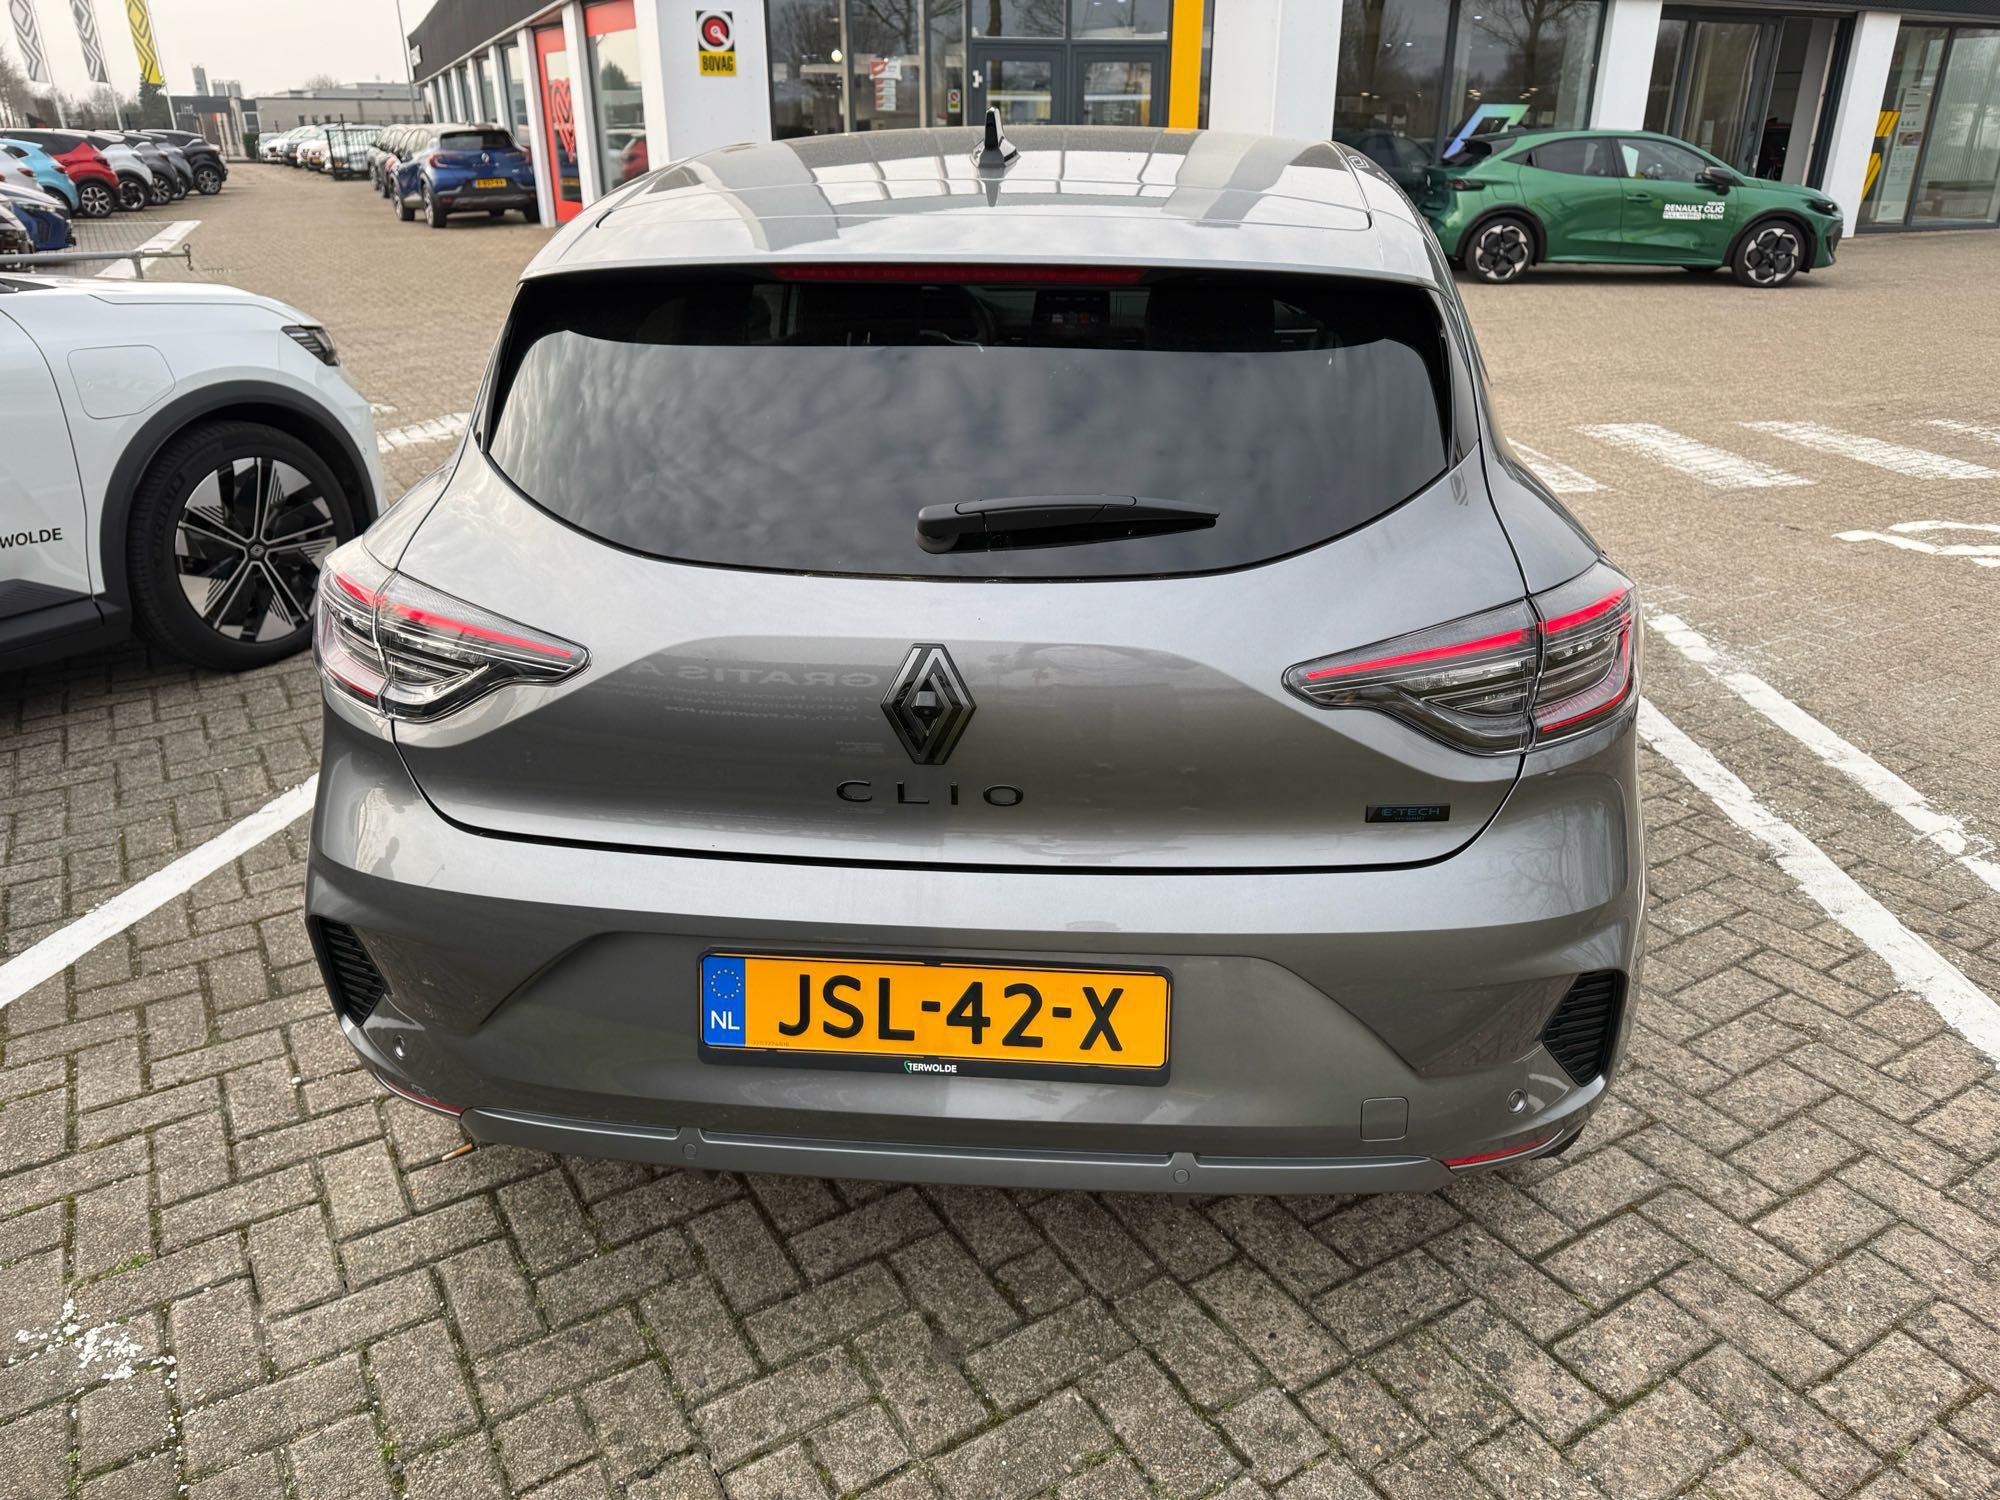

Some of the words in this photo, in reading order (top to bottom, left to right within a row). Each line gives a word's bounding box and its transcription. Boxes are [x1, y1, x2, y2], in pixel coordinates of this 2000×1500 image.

[702, 55, 734, 72] BOVAG
[1664, 203, 1703, 213] RENAULT
[1703, 205, 1725, 214] CLIO
[836, 780, 1024, 807] CLIO
[1381, 807, 1440, 816] E-TECH
[711, 1010, 740, 1030] NL
[778, 974, 1124, 1051] JSL-42-X
[906, 1062, 958, 1073] TERWOLDE
